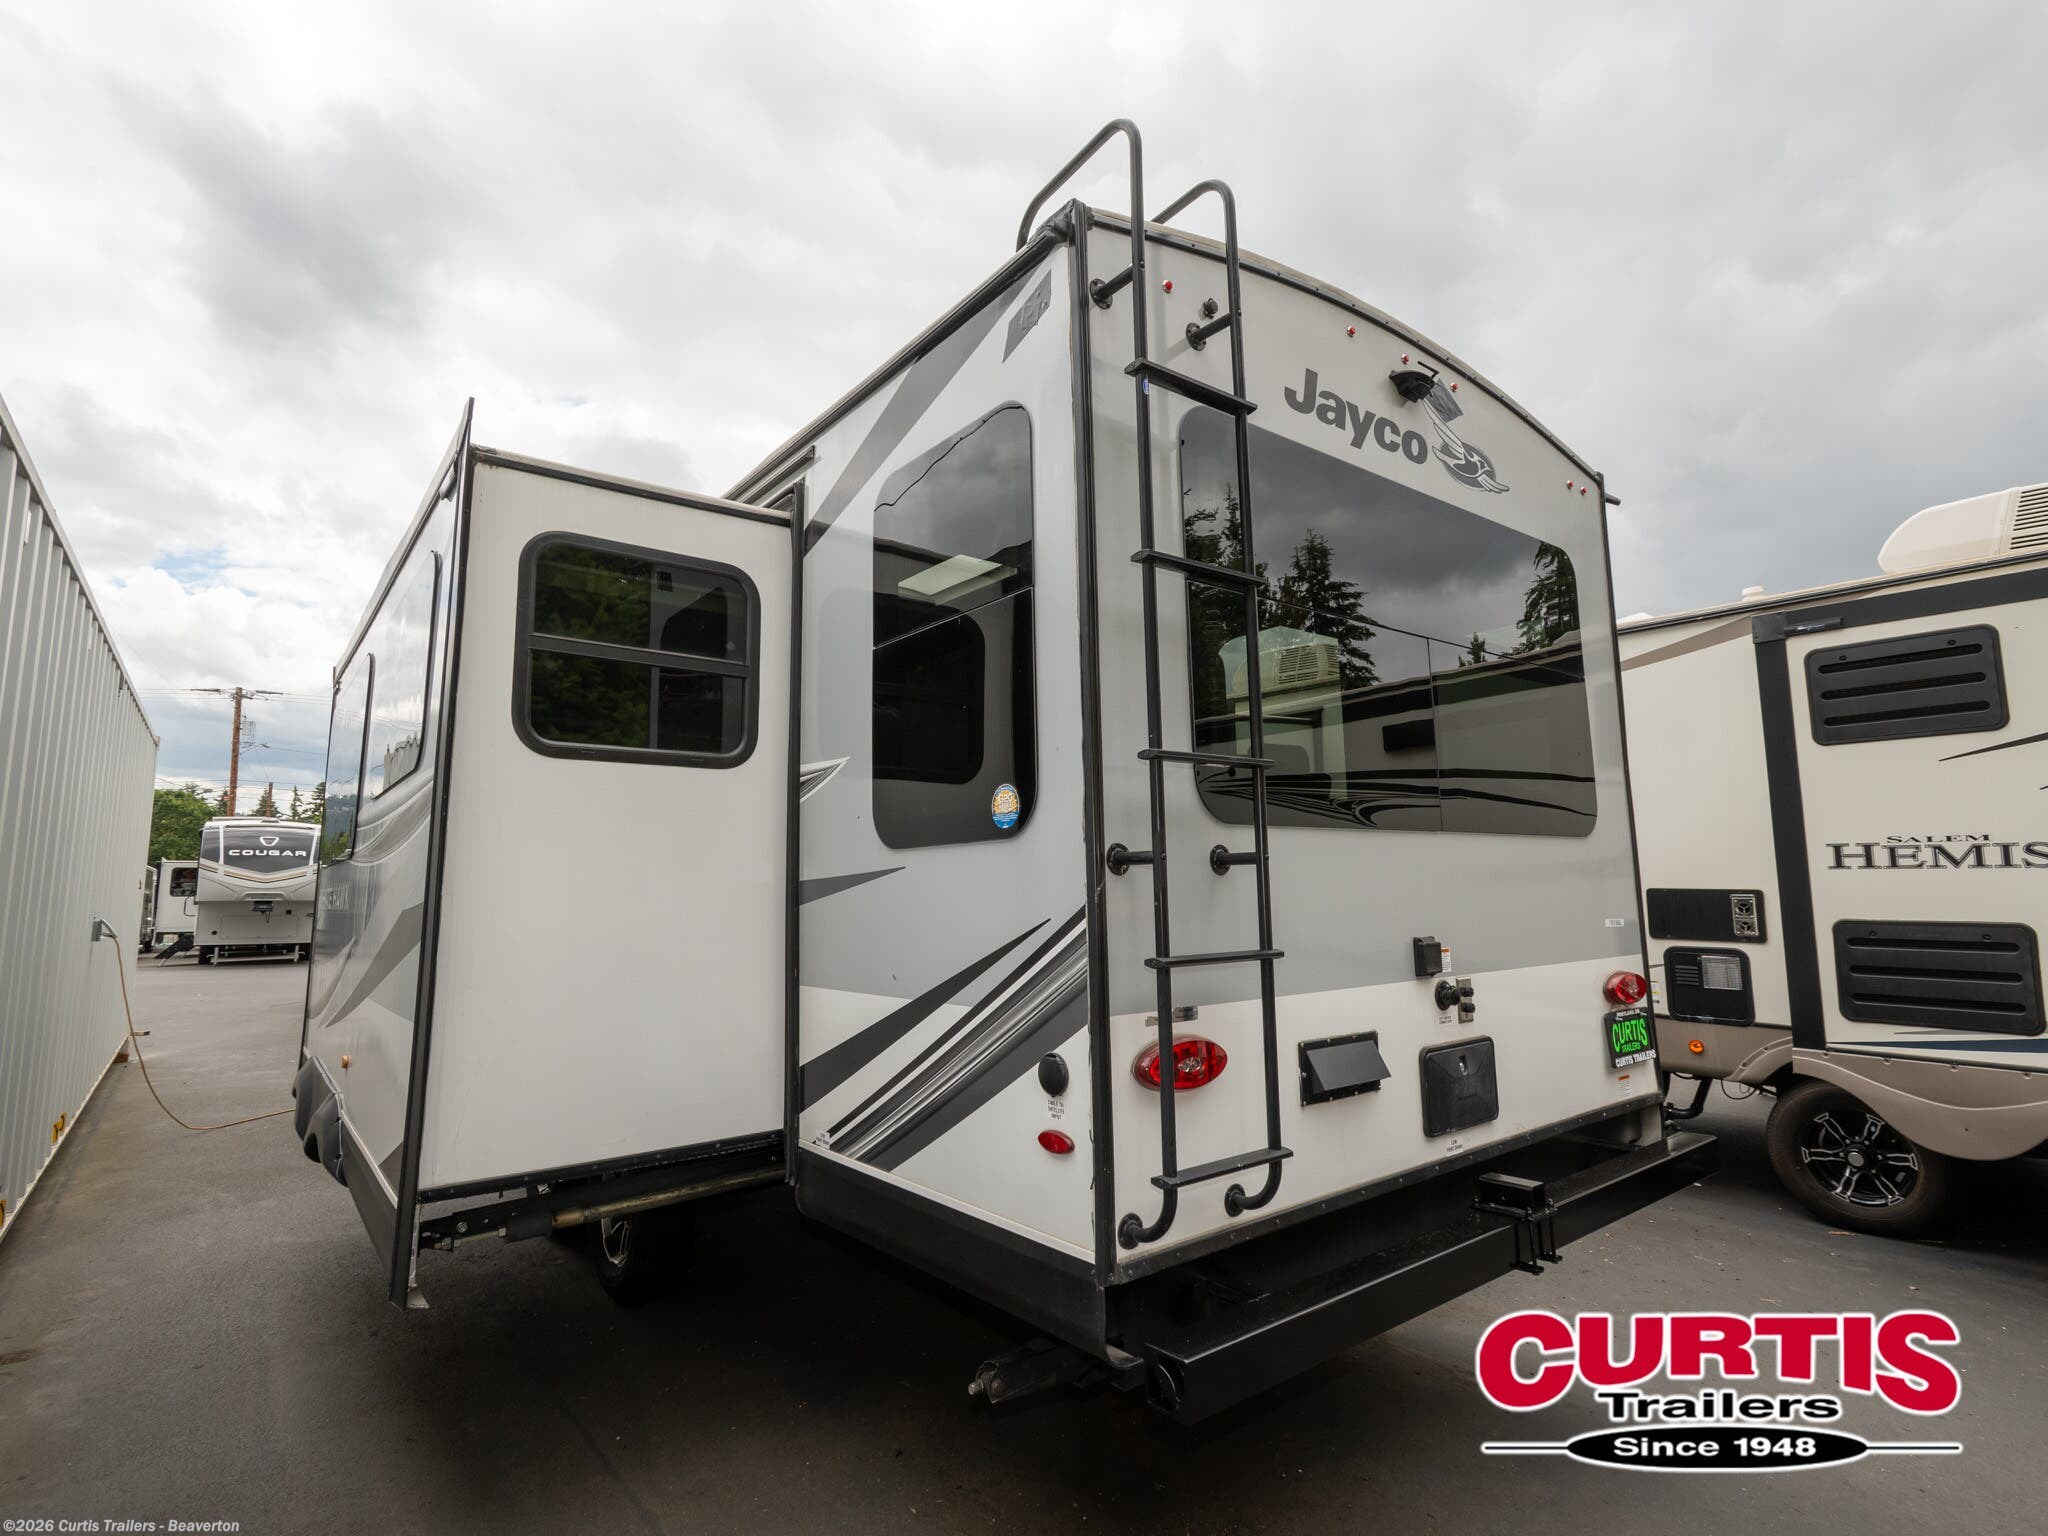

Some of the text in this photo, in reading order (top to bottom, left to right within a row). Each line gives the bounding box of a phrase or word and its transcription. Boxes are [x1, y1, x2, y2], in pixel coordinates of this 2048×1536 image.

[1284, 368, 1428, 464] Jayco
[1887, 834, 1990, 843] SALEM
[228, 849, 307, 857] COUGAR
[1612, 1018, 1648, 1052] CURTIS
[1622, 1041, 1641, 1053] TRAILERS
[1615, 1049, 1656, 1067] CURTIS TRAILERS
